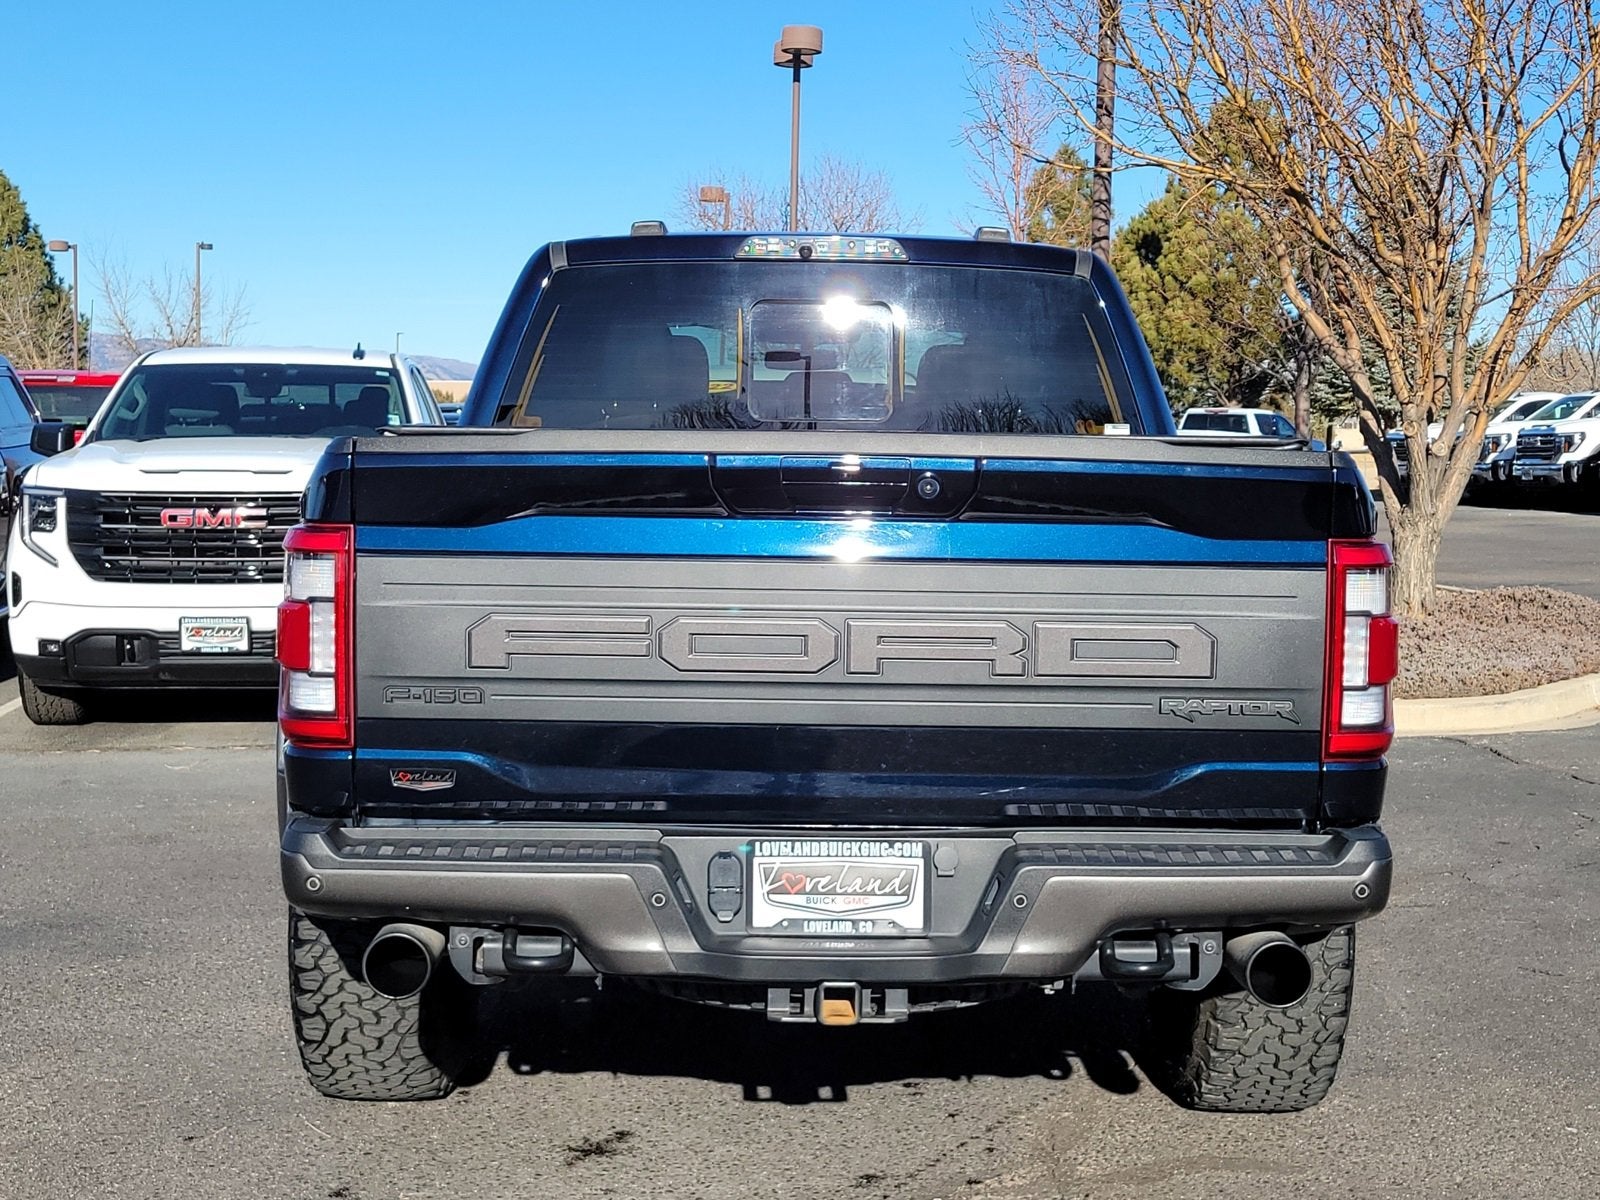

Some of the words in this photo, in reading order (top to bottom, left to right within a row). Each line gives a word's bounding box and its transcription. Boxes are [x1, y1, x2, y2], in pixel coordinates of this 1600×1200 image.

[160, 507, 268, 529] GMC
[467, 613, 1217, 678] FORD
[384, 685, 485, 704] F-150
[1159, 698, 1301, 725] RAPTOR
[754, 841, 923, 857] LOVELANDBUICKGMC.COM
[805, 896, 837, 905] BUICK
[843, 896, 870, 905] GMC
[803, 920, 856, 933] LOVELAND,
[858, 921, 874, 933] CO
